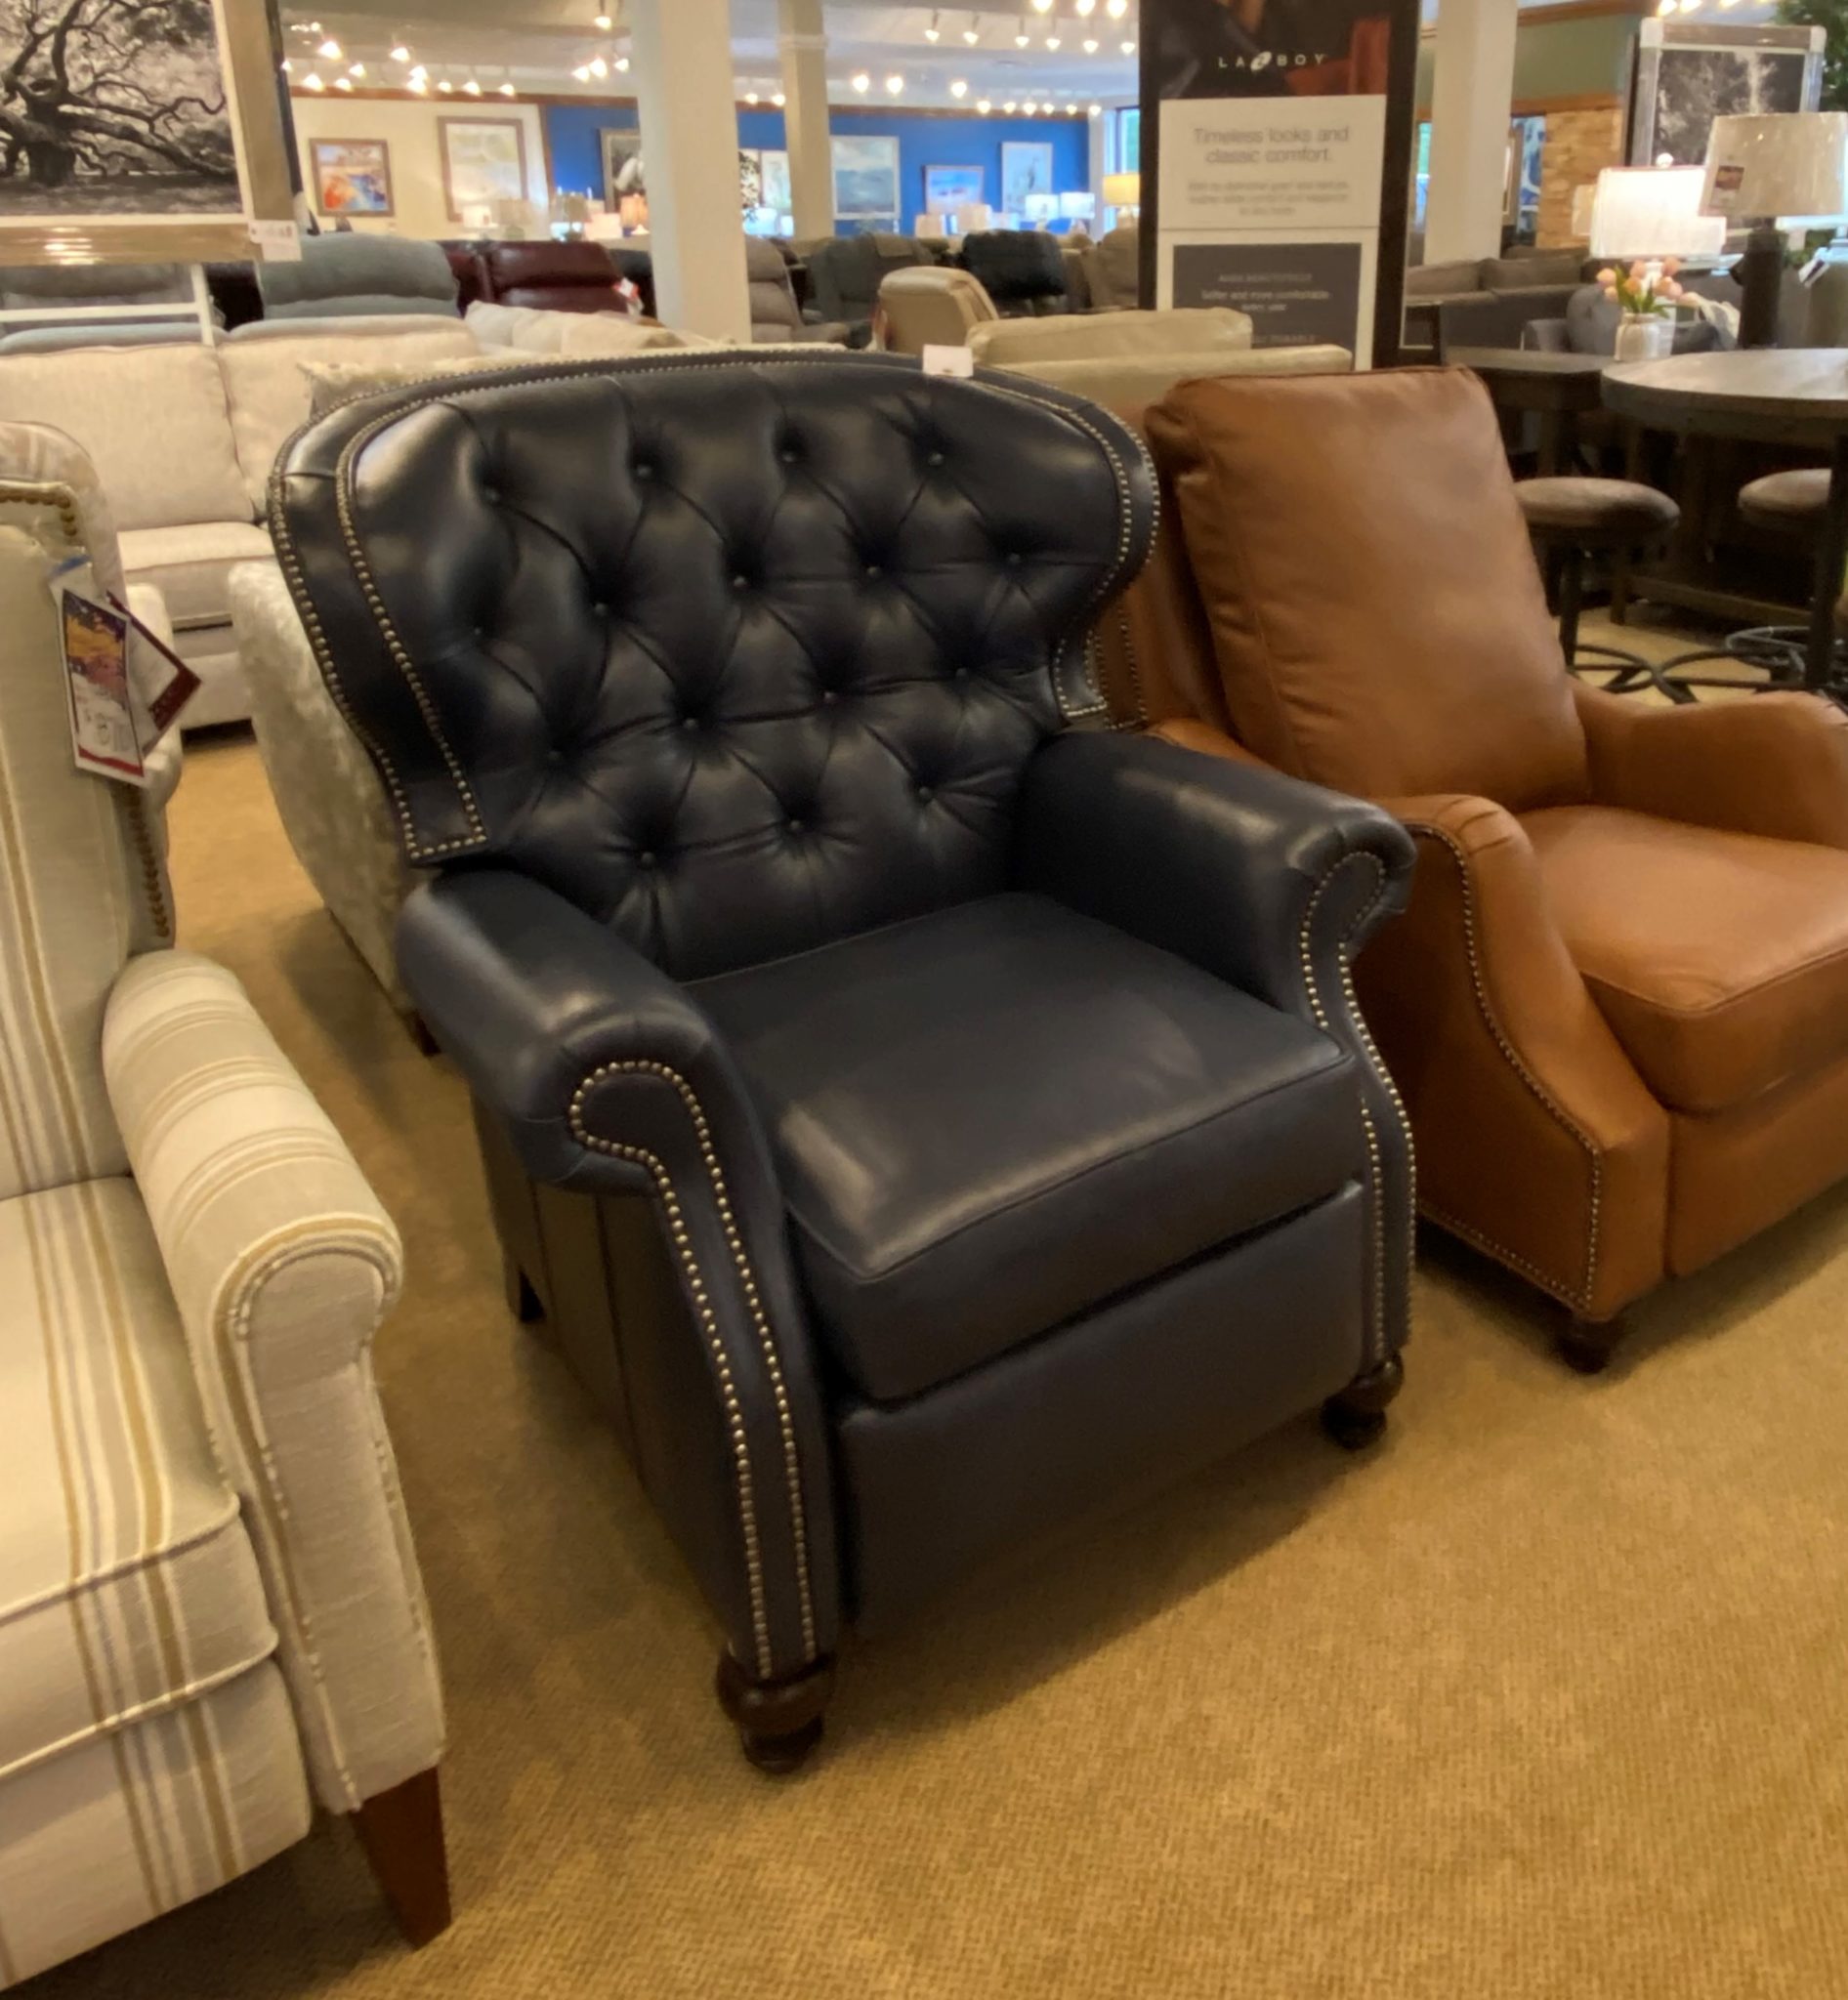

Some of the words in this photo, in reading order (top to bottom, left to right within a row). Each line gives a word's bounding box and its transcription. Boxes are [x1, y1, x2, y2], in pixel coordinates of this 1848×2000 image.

[1269, 127, 1312, 143] looks
[1318, 126, 1350, 143] and
[1205, 148, 1260, 164] classic
